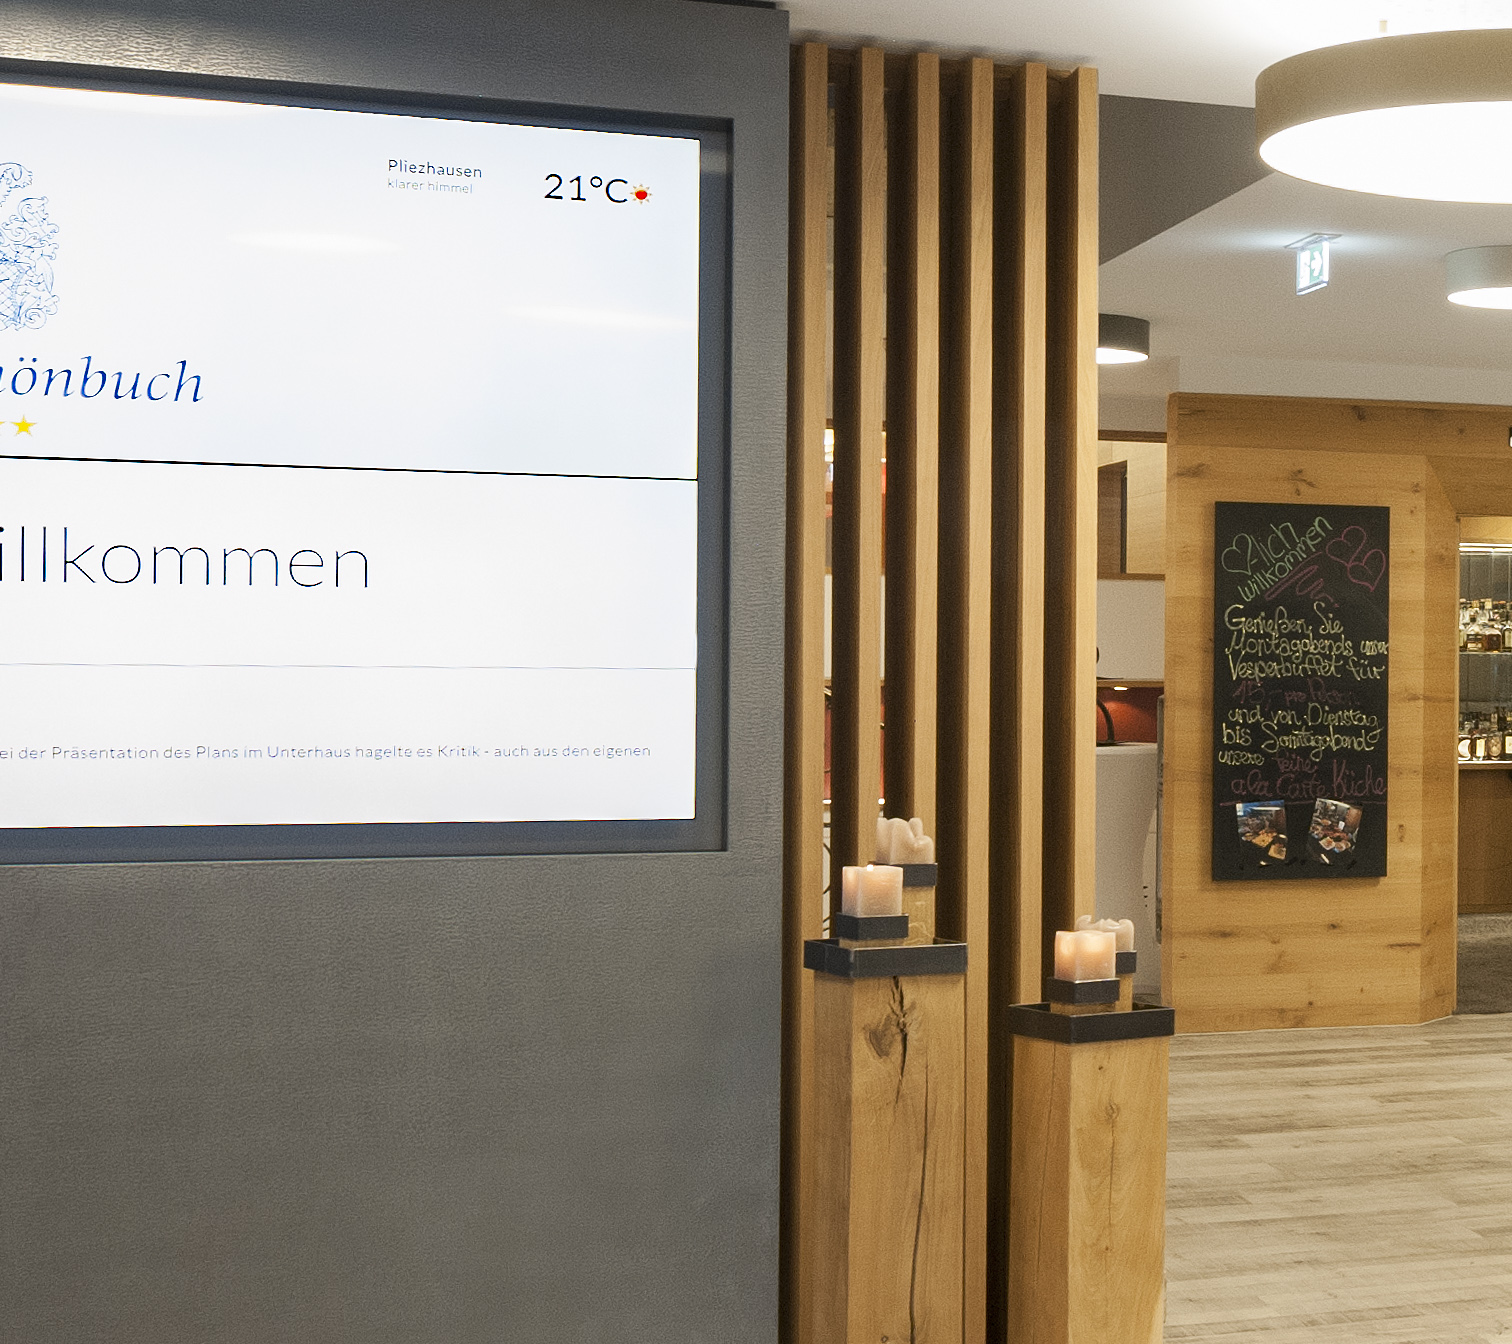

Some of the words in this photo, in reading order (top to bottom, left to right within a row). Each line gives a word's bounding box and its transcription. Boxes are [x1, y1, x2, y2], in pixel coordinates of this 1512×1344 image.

[389, 160, 481, 177] Pliezhausen
[387, 178, 424, 191] klarer
[427, 181, 473, 194] himmel
[545, 174, 628, 203] 21°C
[1314, 601, 1344, 634] Sie
[1346, 656, 1386, 681] für
[1222, 723, 1253, 745] bis
[1228, 705, 1265, 723] und
[1270, 709, 1302, 725] von
[1303, 702, 1384, 743] Dienstag
[18, 746, 47, 760] der
[52, 746, 159, 759] Präsentation
[163, 746, 191, 759] des
[196, 745, 239, 759] Plans
[267, 746, 351, 759] Unterhaus
[355, 745, 413, 761] hagelte
[416, 748, 433, 758] es
[438, 745, 480, 757] Kritik
[493, 745, 529, 758] auch
[533, 747, 558, 757] aus
[562, 745, 590, 757] den
[593, 744, 651, 760] eigenen
